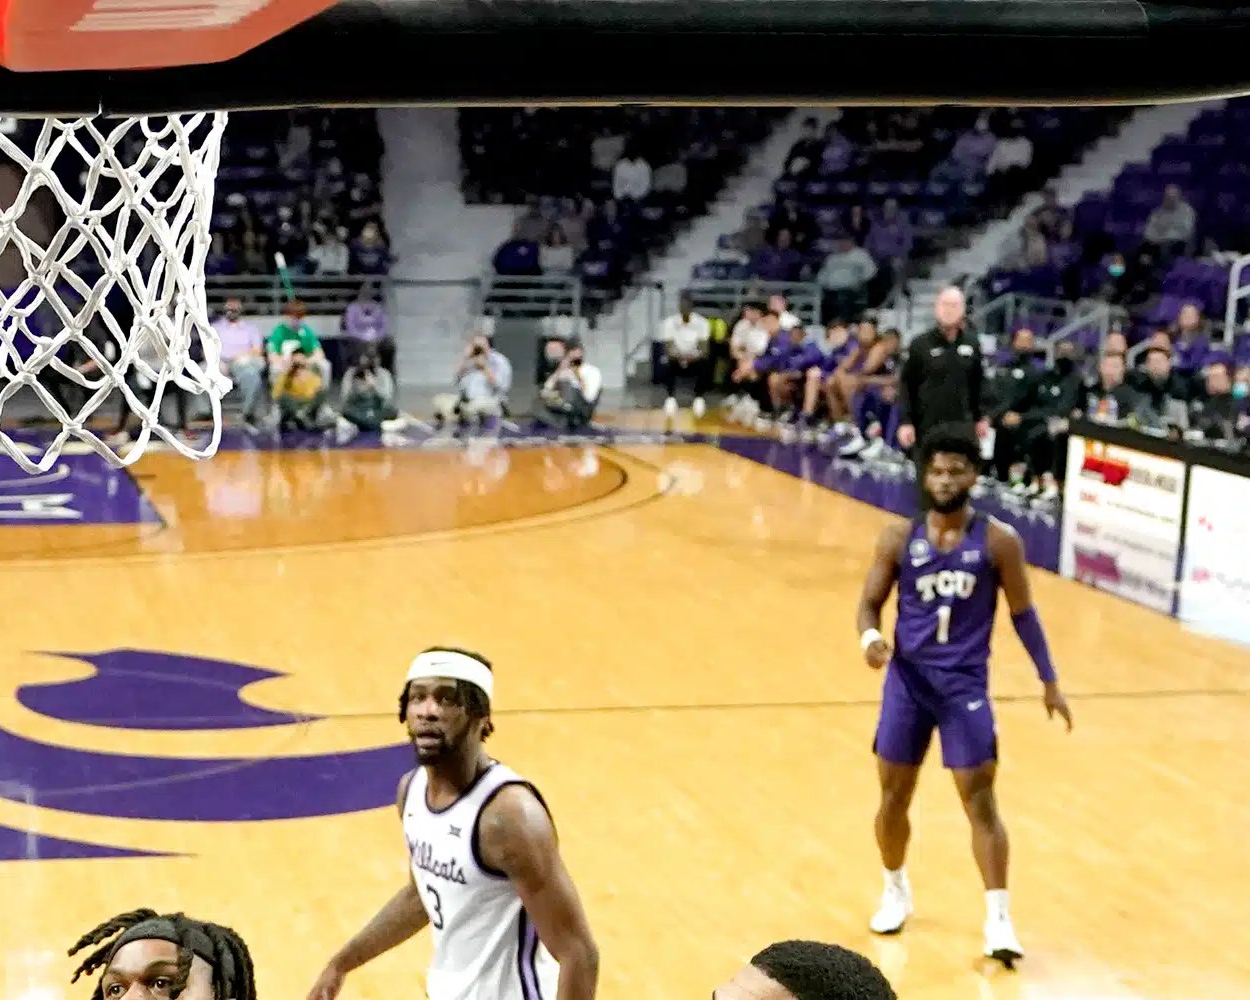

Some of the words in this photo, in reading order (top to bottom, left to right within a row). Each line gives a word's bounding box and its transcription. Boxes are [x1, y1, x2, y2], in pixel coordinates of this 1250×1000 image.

[915, 569, 977, 602] TCU
[936, 605, 951, 644] 1
[426, 884, 444, 931] 3
